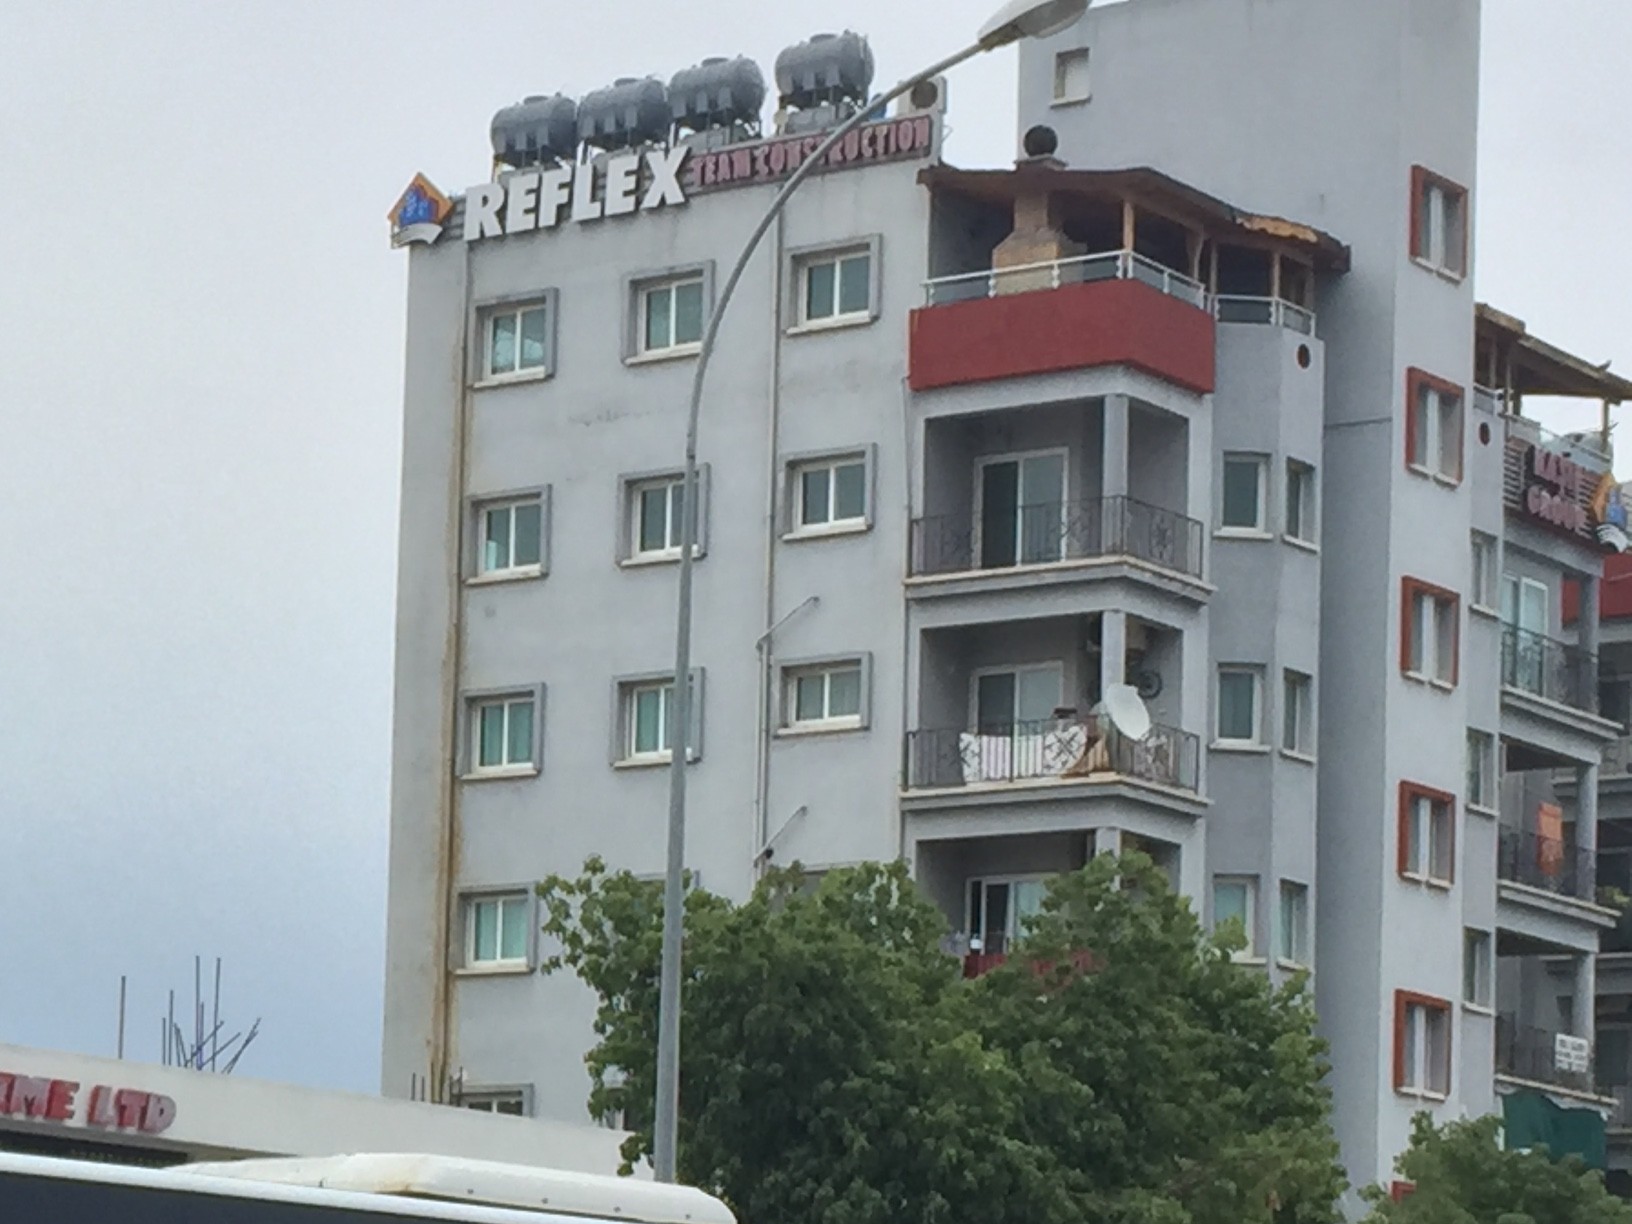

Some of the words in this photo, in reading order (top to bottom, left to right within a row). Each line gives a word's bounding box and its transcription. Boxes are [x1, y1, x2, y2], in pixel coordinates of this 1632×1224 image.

[690, 149, 751, 186] TEAM
[464, 146, 694, 241] REFLEX
[86, 1084, 178, 1135] LTD
